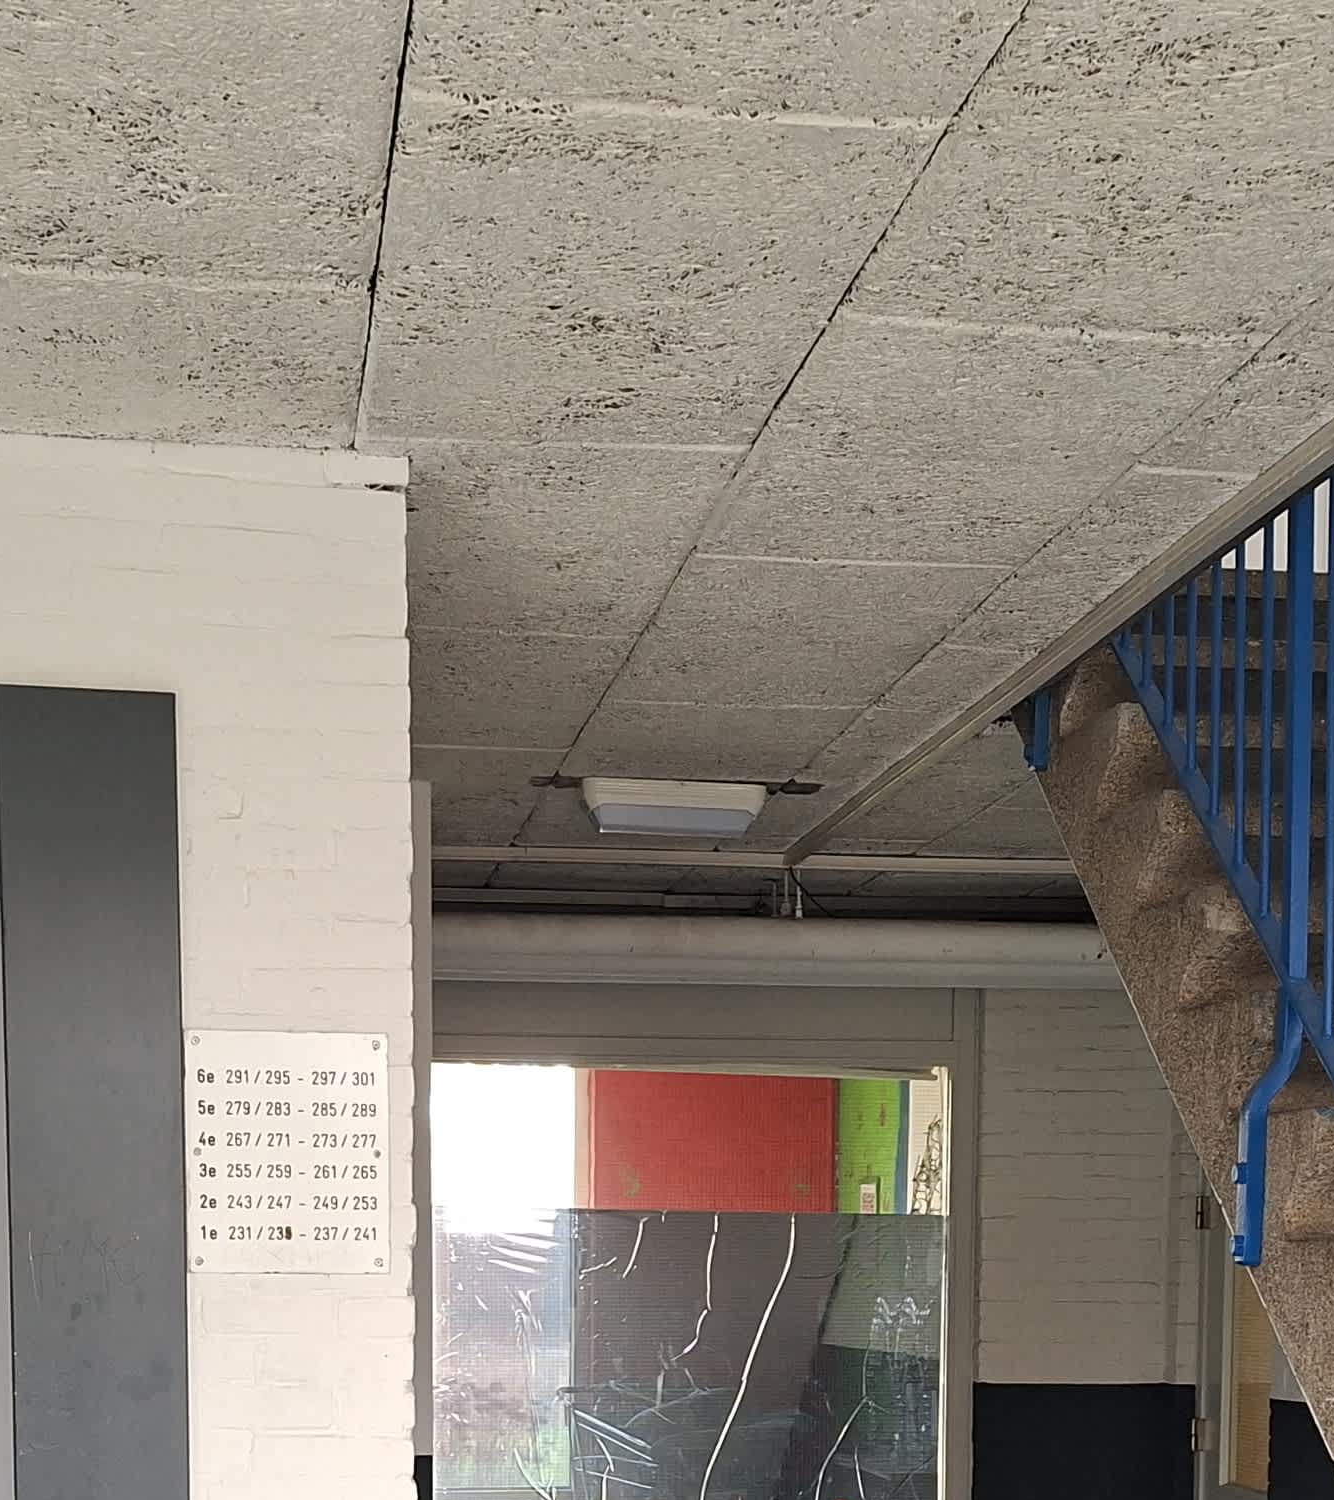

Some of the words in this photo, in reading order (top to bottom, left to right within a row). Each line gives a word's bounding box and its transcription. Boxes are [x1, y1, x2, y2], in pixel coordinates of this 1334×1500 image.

[197, 1069, 214, 1083] 6e
[198, 1100, 215, 1115] 5e
[199, 1132, 215, 1146] 4e
[199, 1163, 216, 1177] 3e
[200, 1194, 216, 1208] 2e
[201, 1225, 217, 1240] 1e
